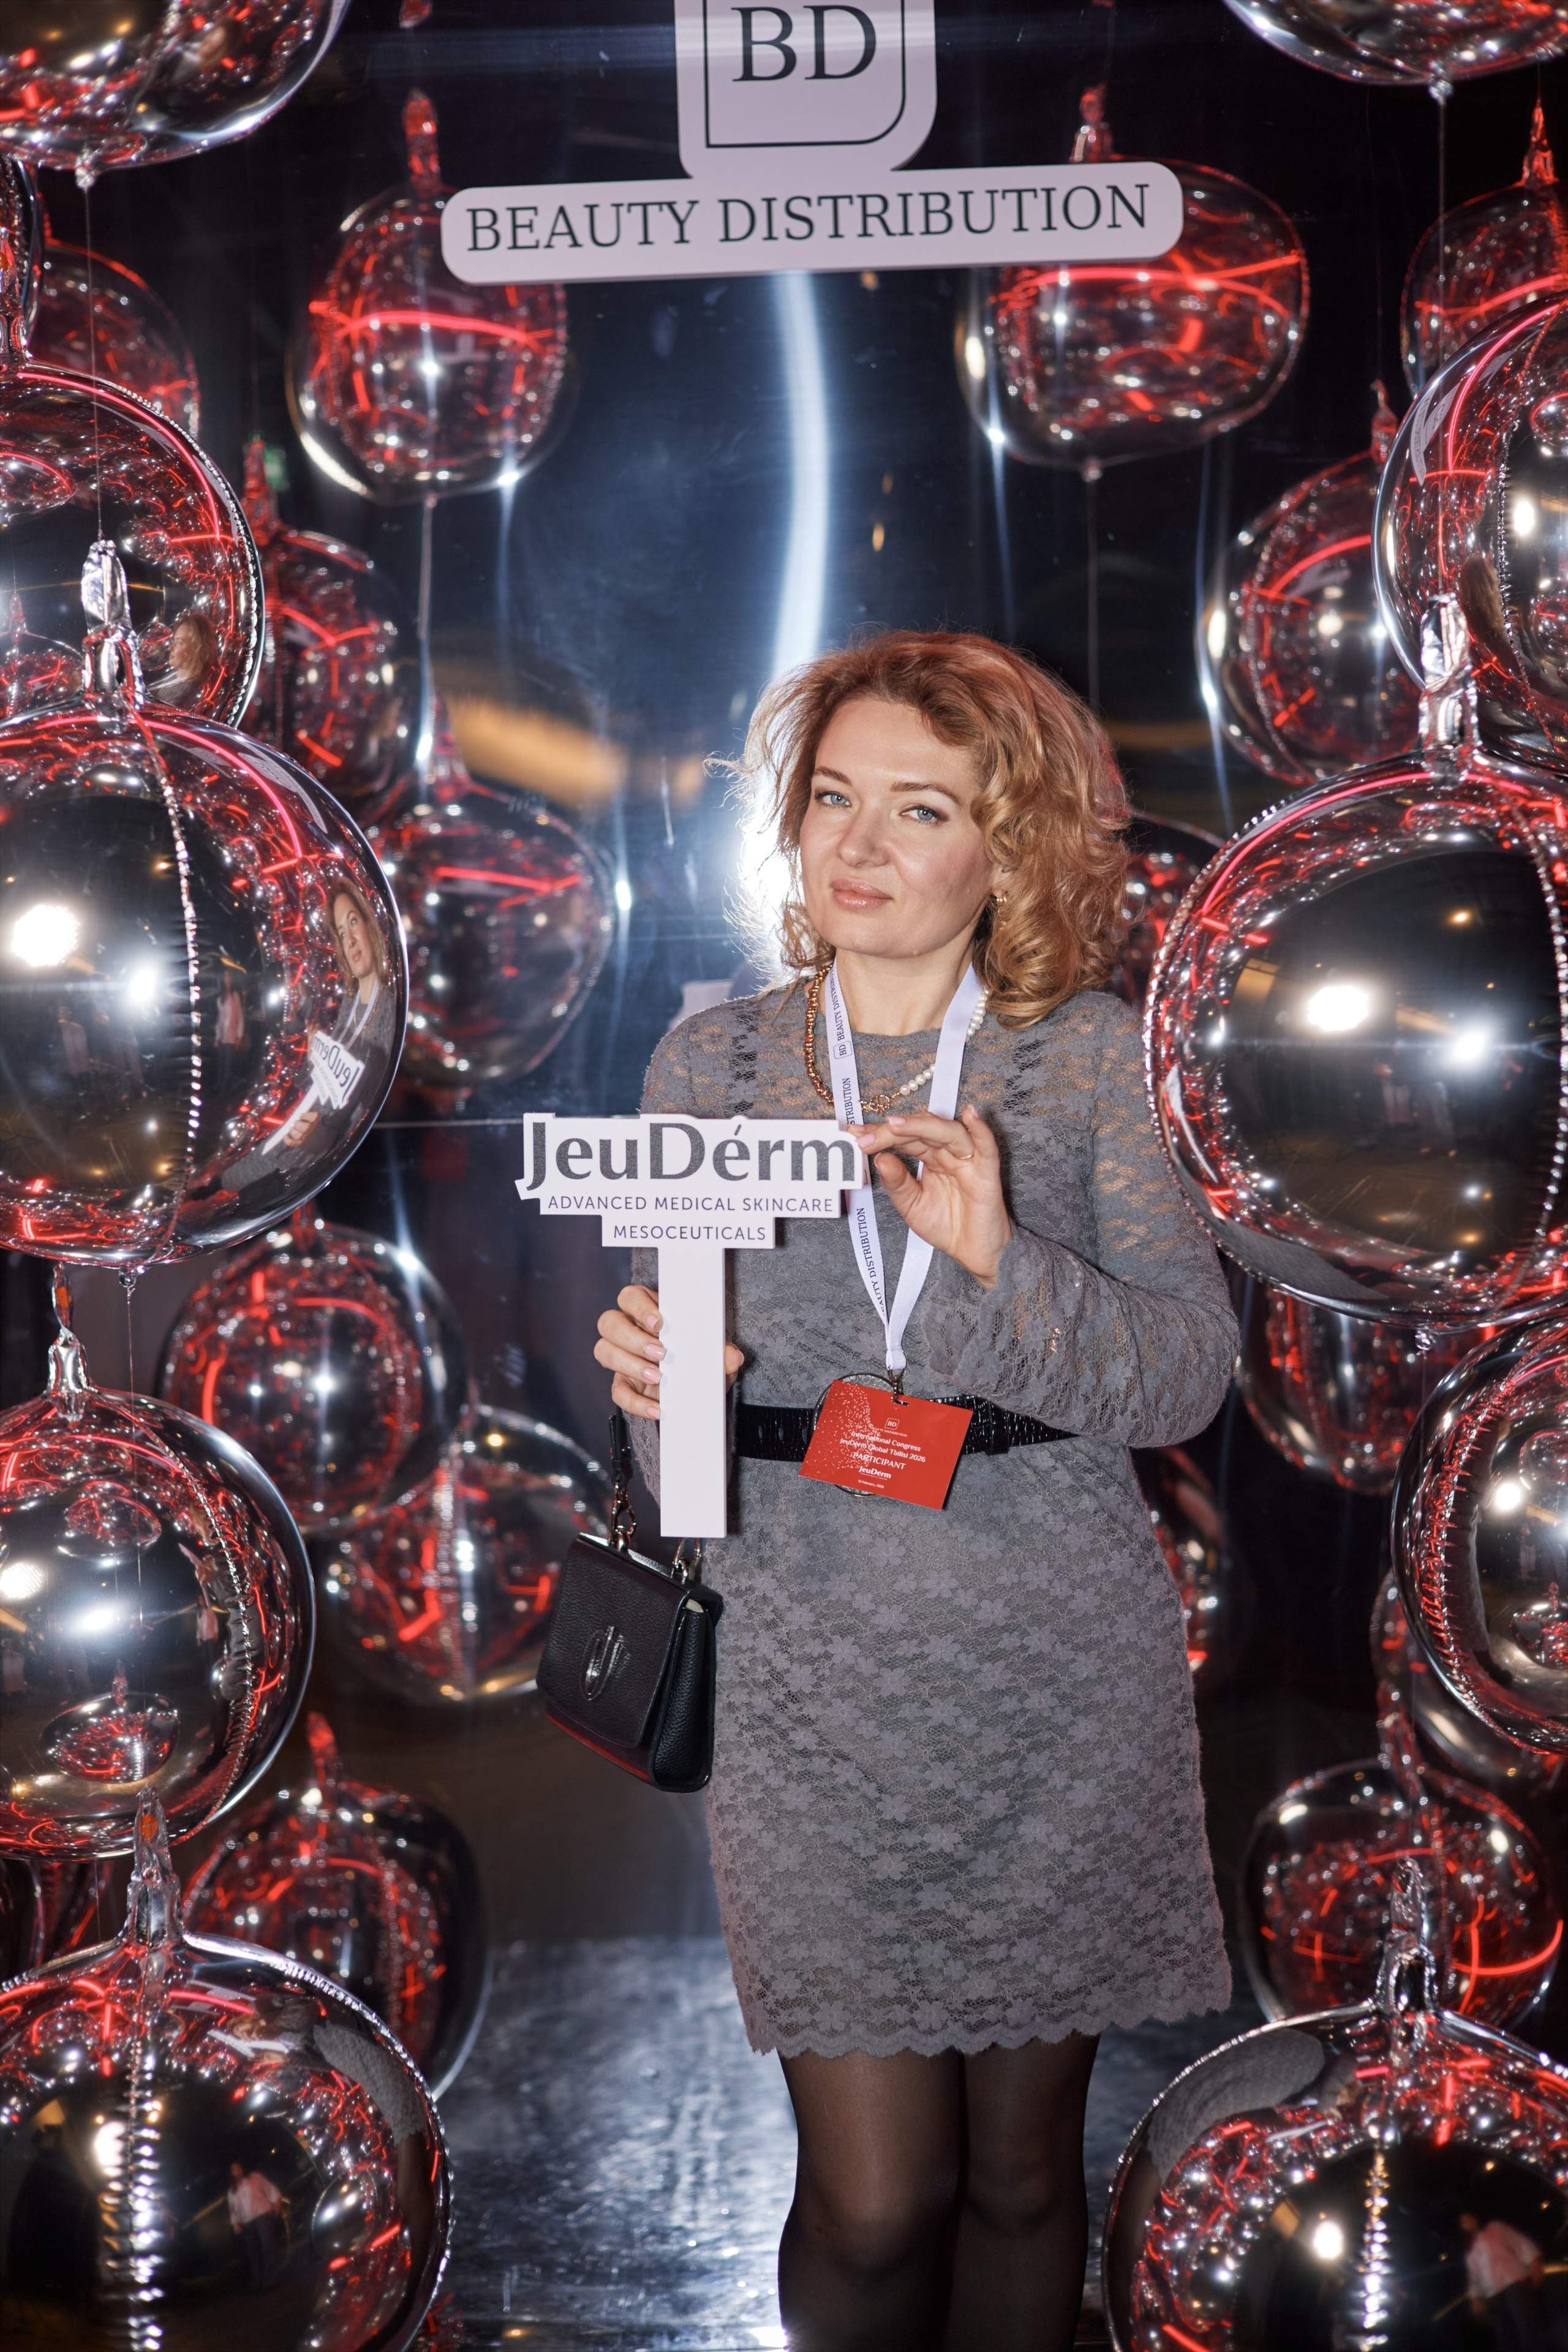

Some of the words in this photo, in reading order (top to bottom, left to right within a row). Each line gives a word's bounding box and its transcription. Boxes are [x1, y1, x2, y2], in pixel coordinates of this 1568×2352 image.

[731, 5, 876, 81] BD
[467, 200, 698, 251] BEAUTY
[718, 184, 1150, 243] DISTRIBUTION
[835, 1011, 845, 1041] BEAUTY
[839, 1044, 847, 1056] BD
[526, 1122, 855, 1191] JeuDérm
[548, 1196, 647, 1210] ADVANCED
[655, 1197, 736, 1211] MEDICAL
[743, 1198, 833, 1212] SKINCARE
[614, 1226, 766, 1240] MESOCEUTICALS
[856, 1208, 876, 1278] DISTRIBUTION
[851, 1431, 891, 1444] International
[892, 1440, 921, 1452] Congress
[853, 1452, 906, 1470] PARTICIPANT
[868, 1444, 888, 1453] Global
[890, 1449, 908, 1458] Tbilisi
[909, 1454, 926, 1463] 2026
